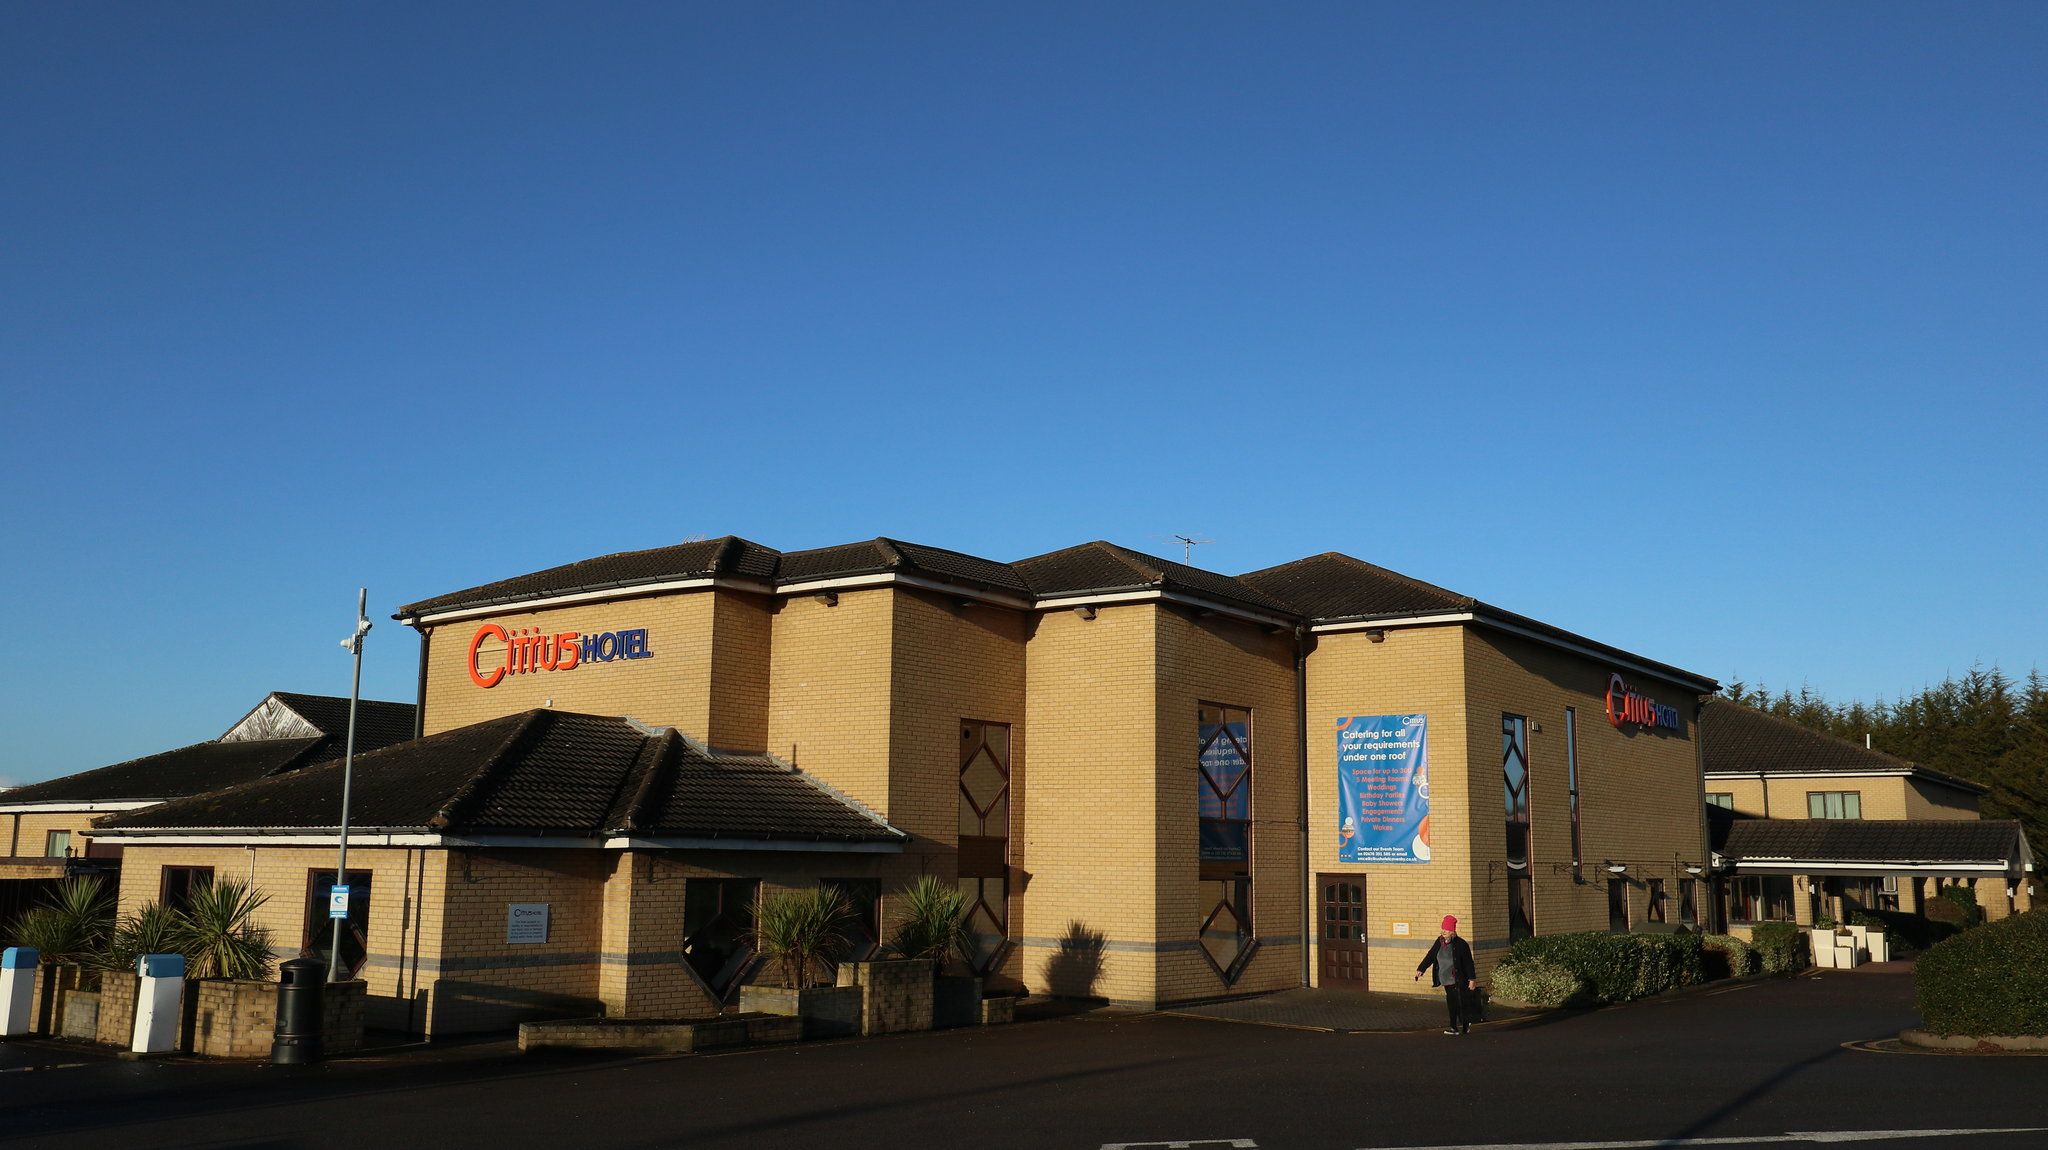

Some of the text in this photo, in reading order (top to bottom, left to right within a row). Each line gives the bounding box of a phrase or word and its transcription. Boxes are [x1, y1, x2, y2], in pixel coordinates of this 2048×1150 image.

[581, 628, 653, 663] HOTEL
[1342, 728, 1406, 739] Catering for all
[1343, 740, 1420, 752] your requirements
[1343, 753, 1367, 761] under
[1389, 751, 1406, 760] roof
